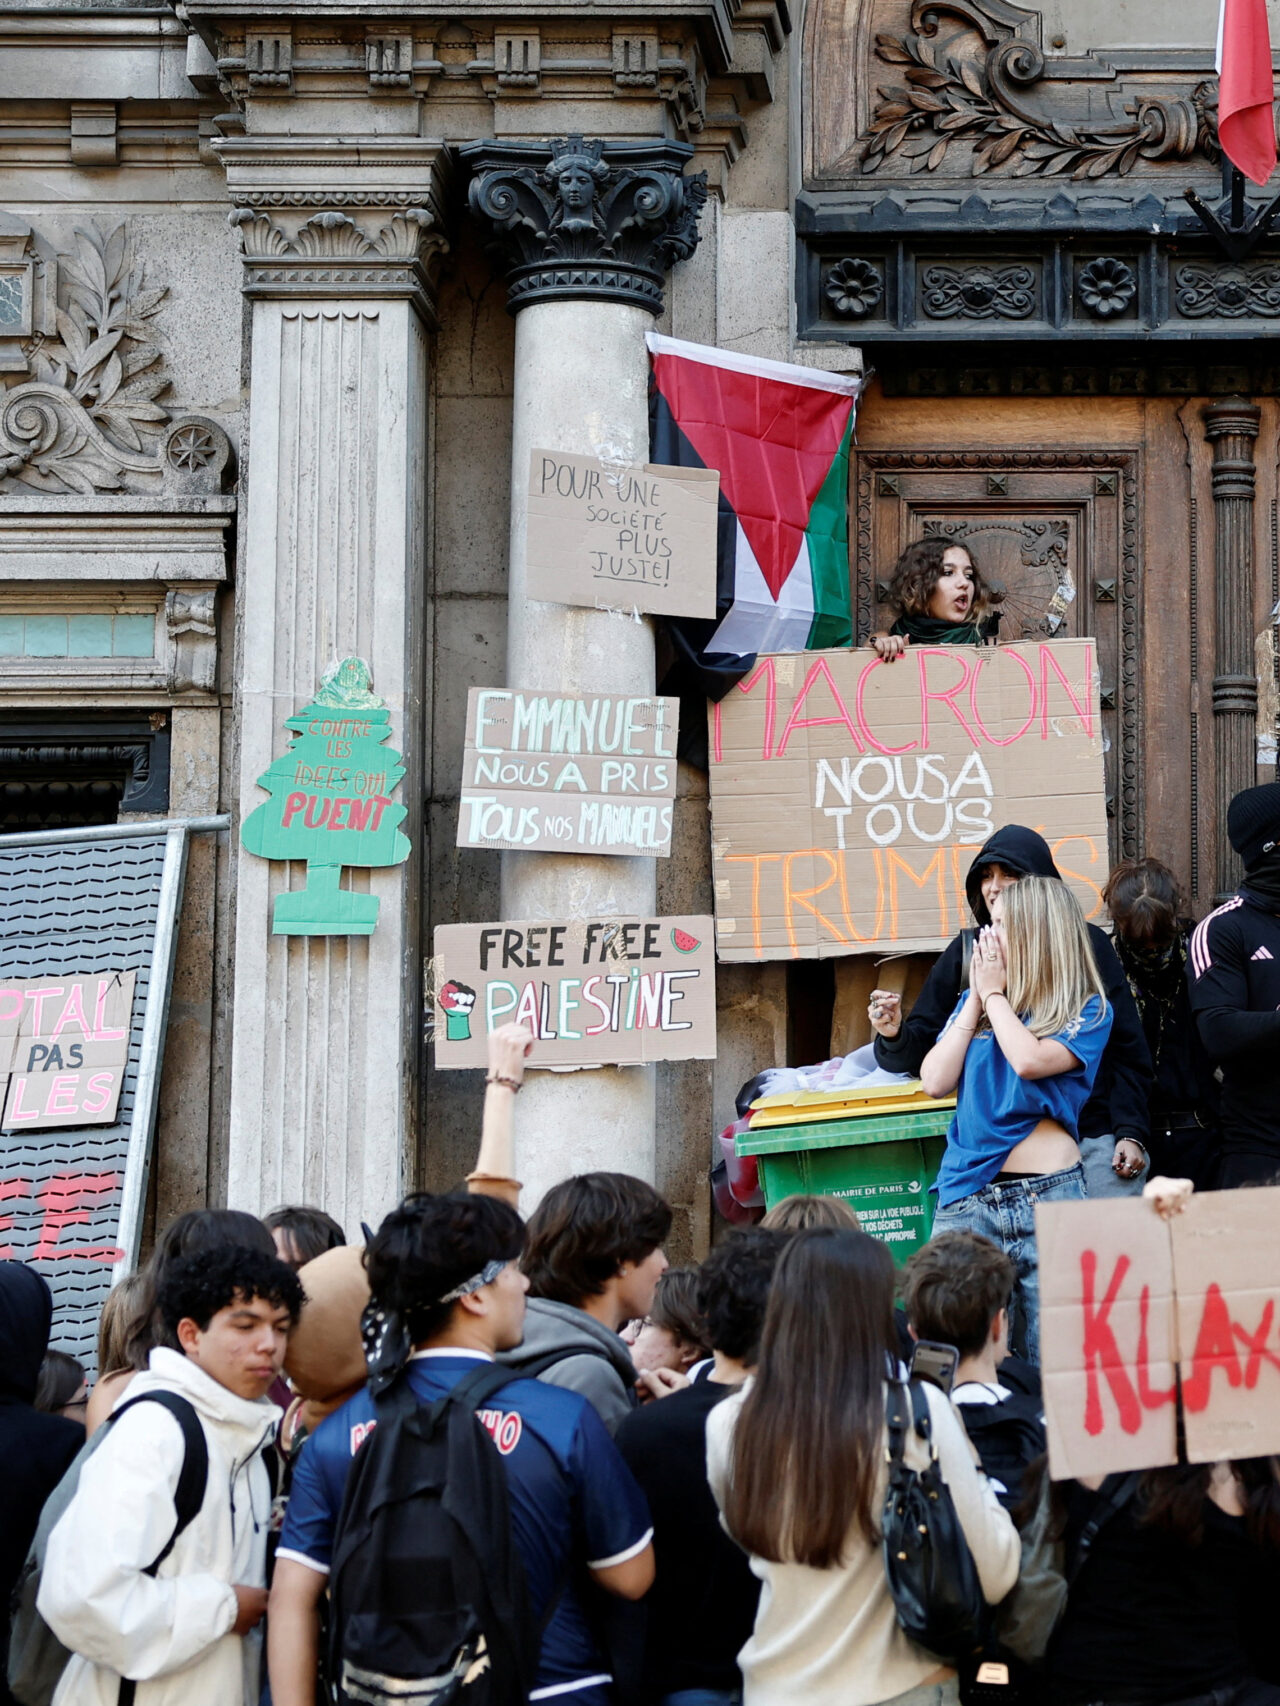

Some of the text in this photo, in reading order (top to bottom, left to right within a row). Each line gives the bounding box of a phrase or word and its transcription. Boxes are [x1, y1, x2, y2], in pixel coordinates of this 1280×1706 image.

[541, 457, 660, 507] POUR UNE
[616, 529, 672, 557] PLUS
[589, 551, 670, 588] JUSTE!
[715, 644, 1094, 762] MACRON
[308, 719, 373, 738] CONTRE
[475, 690, 674, 758] EMMANUEL
[326, 740, 352, 758] LES
[474, 756, 669, 793] NOUS A PRIS
[281, 791, 393, 831] PUENT
[460, 796, 673, 848] TOUS NOS MANUELS
[823, 797, 995, 849] TOUS
[724, 825, 1102, 959] TRUMS
[480, 923, 662, 971] FREE FREE
[27, 1044, 83, 1072] PAS
[8, 1072, 114, 1122] LES
[832, 1184, 903, 1198] MAIRIE DE PARIS
[866, 1222, 877, 1232] VOS
[877, 1219, 903, 1231] DÉCHETS
[869, 1209, 880, 1220] SUR
[880, 1208, 887, 1219] LA
[887, 1207, 900, 1218] VOIE
[884, 1227, 916, 1242] APPROPRIÉ
